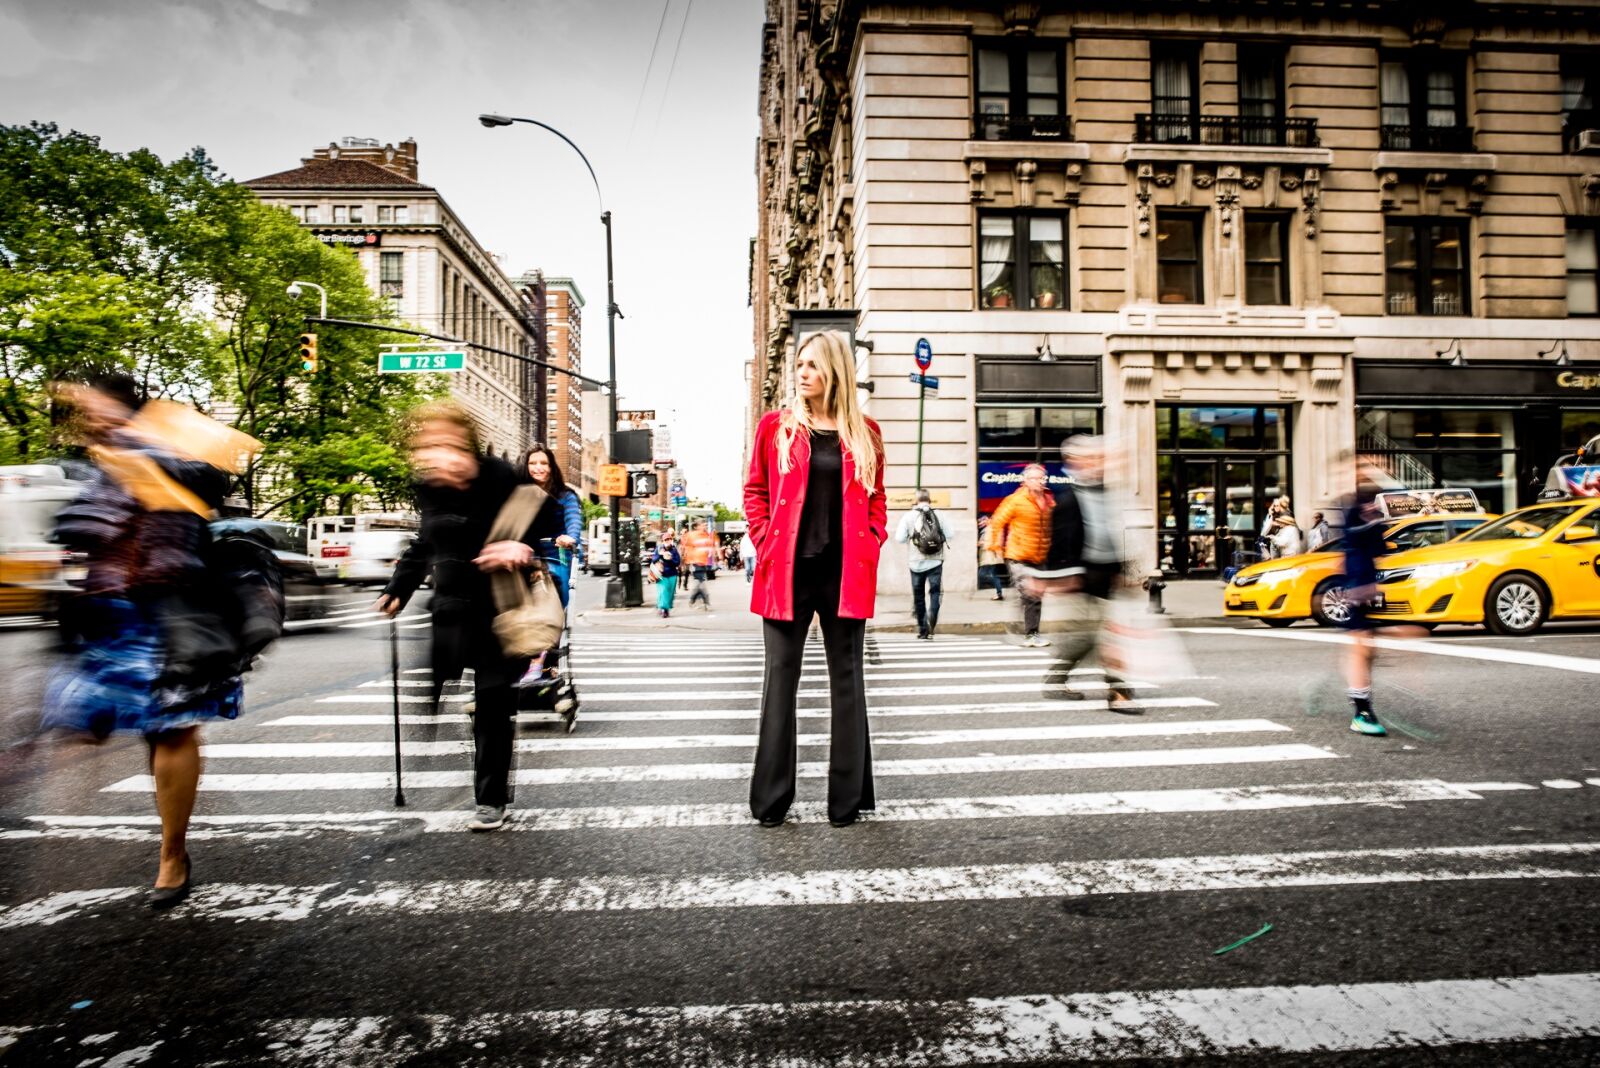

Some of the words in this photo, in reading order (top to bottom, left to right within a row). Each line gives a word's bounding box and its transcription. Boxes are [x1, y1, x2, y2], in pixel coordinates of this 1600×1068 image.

[331, 234, 365, 244] Savings
[400, 357, 412, 368] W
[416, 356, 430, 368] 72
[433, 356, 447, 368] St
[631, 411, 642, 421] 72
[981, 472, 1026, 484] Capita
[1048, 475, 1075, 484] Bank
